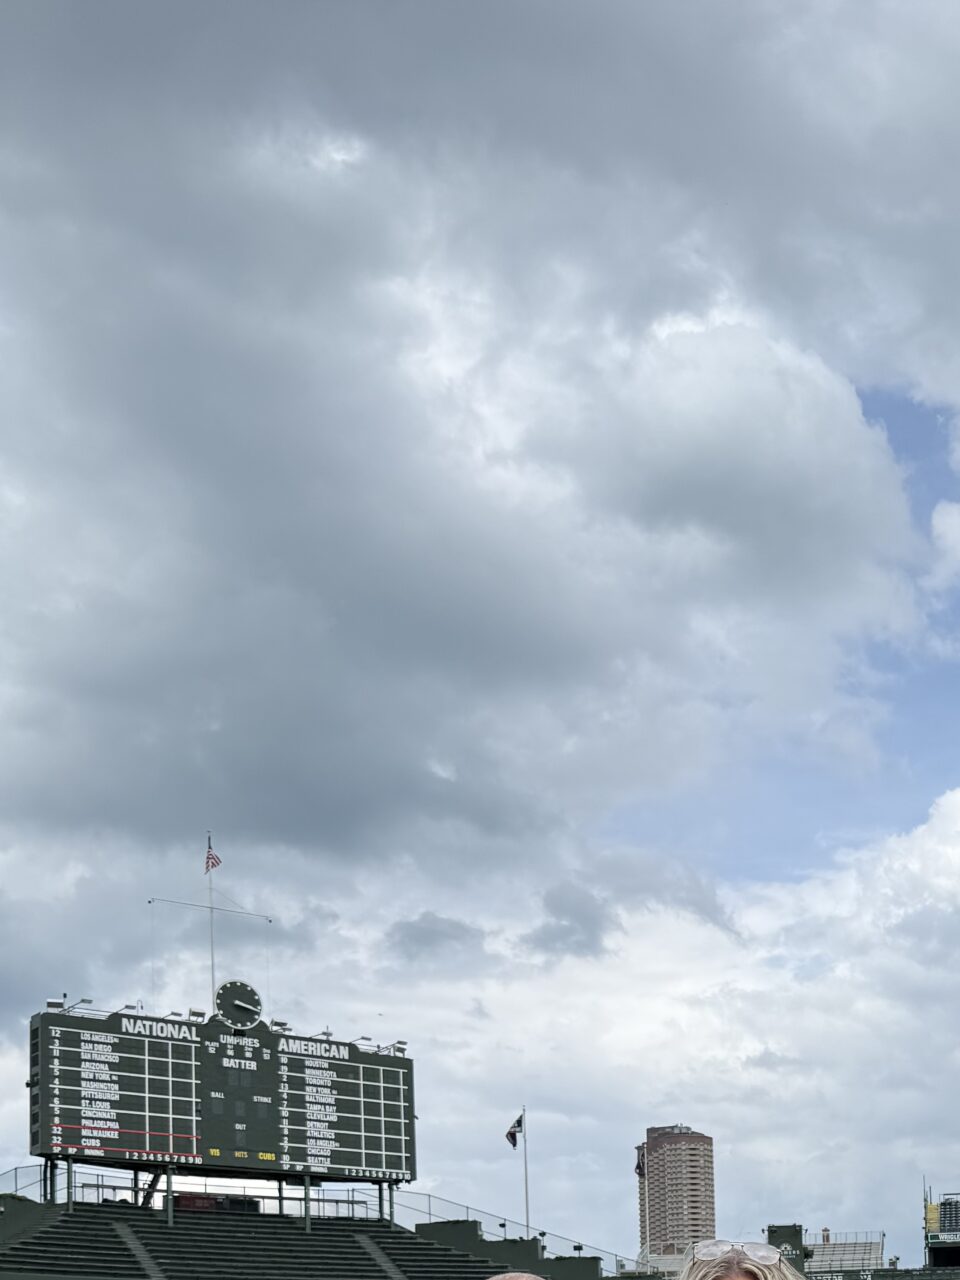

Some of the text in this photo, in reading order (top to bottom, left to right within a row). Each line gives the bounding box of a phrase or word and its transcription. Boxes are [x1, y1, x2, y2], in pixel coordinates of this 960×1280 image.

[121, 1018, 200, 1041] NATIONAL
[92, 1034, 113, 1043] ANGELES
[220, 1034, 260, 1048] UMPIRES
[81, 1042, 93, 1050] SAN
[94, 1044, 112, 1052] DIEGO
[278, 1038, 350, 1060] AMERICAN
[81, 1052, 91, 1060] SAN
[92, 1054, 120, 1063] FRANCISCO
[81, 1062, 109, 1071] ARIZONA
[222, 1058, 257, 1070] BATTER
[305, 1060, 328, 1068] HOUSTON
[95, 1073, 111, 1081] YORK
[305, 1068, 337, 1078] MINNESOTA
[81, 1081, 119, 1090] WASHINGTON
[305, 1078, 332, 1086] TORONTO
[81, 1091, 120, 1100] PITTSBURGH
[210, 1091, 224, 1099] BALL
[318, 1087, 331, 1095] YORK
[305, 1095, 336, 1104] BALTIMORE
[306, 1104, 325, 1112] TAMPA
[81, 1110, 116, 1119] CINCINNATI
[307, 1113, 338, 1122] CLEVELAND
[81, 1119, 120, 1129] PHILADELPHIA
[307, 1121, 328, 1129] DETROIT
[81, 1129, 120, 1138] MILWAUKEE
[307, 1130, 335, 1139] ATHLETICS
[81, 1138, 101, 1147] CUBS
[258, 1152, 276, 1161] CUBS
[307, 1148, 331, 1156] CHICAGO
[307, 1156, 331, 1165] SEATTLE
